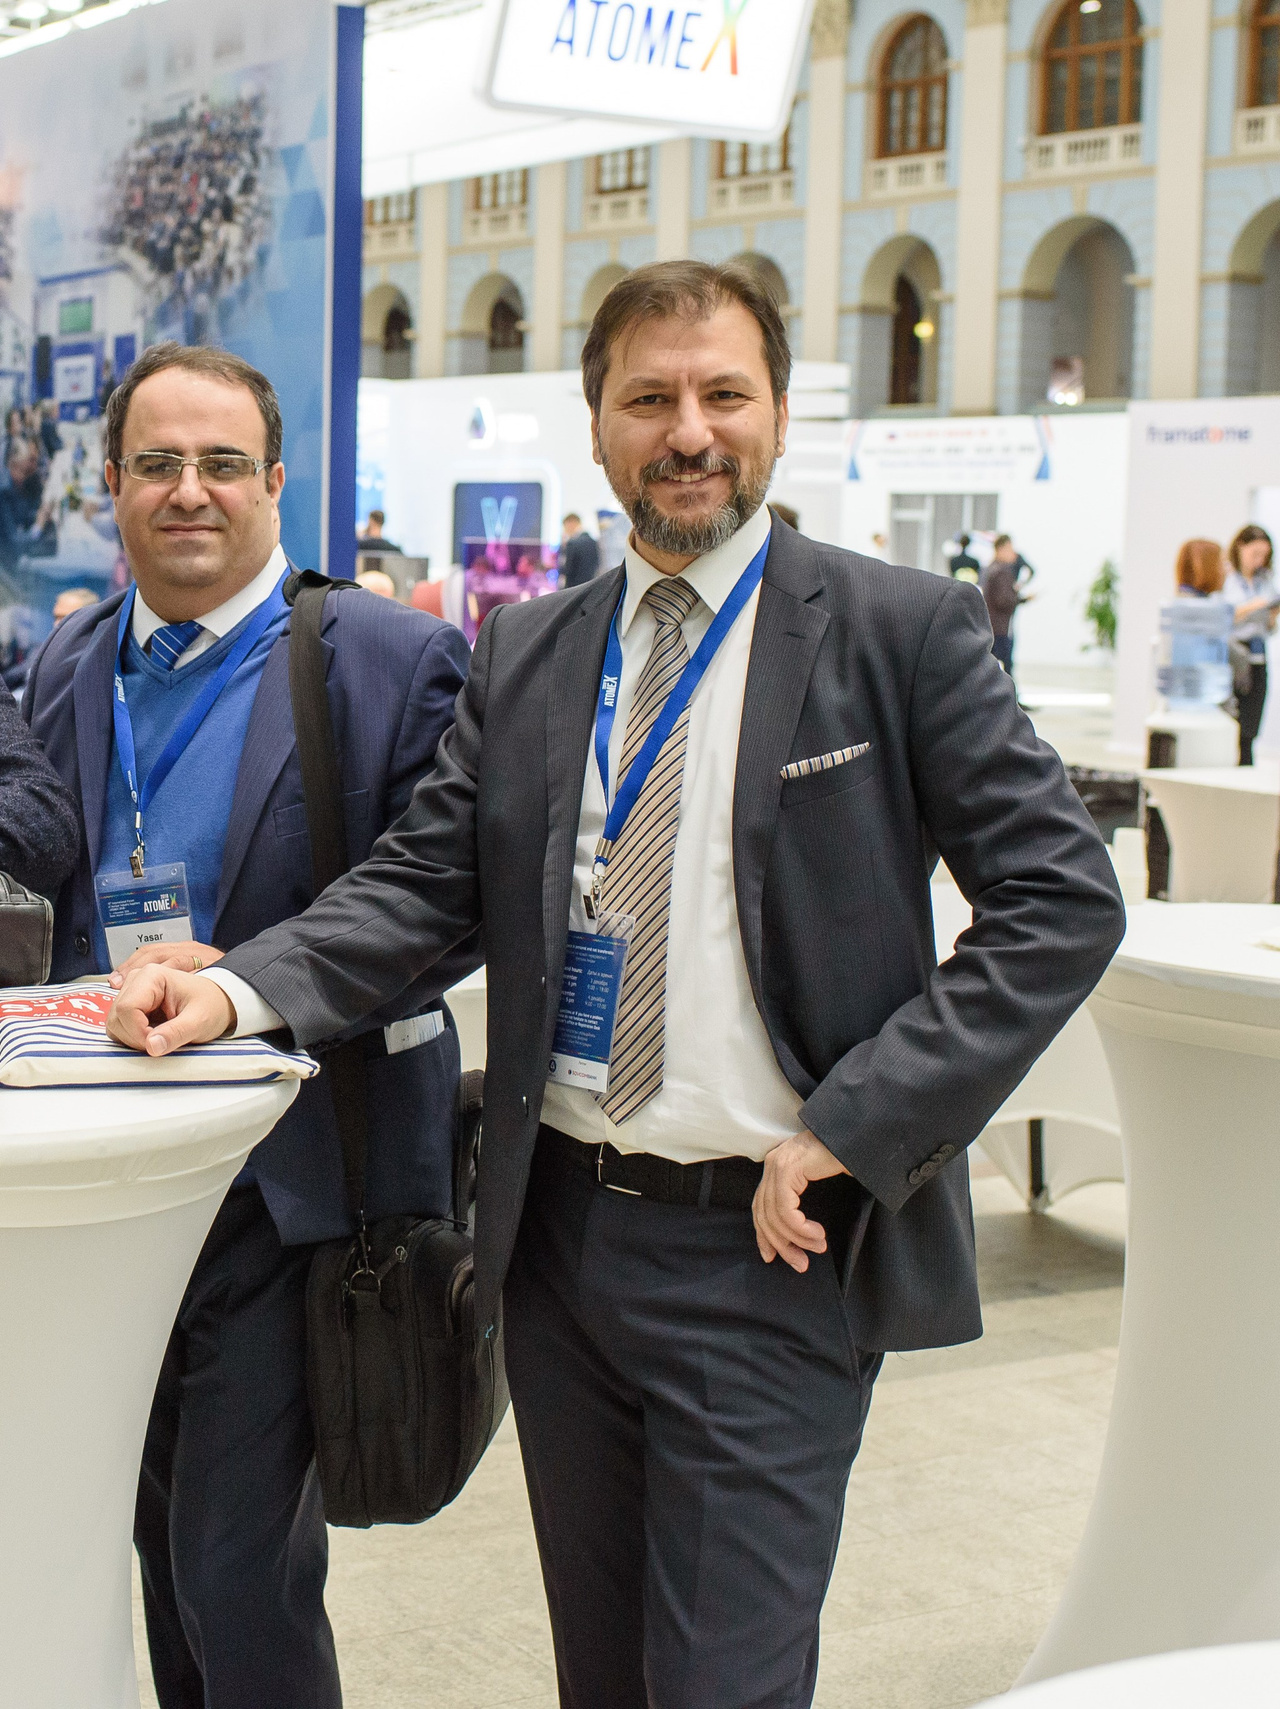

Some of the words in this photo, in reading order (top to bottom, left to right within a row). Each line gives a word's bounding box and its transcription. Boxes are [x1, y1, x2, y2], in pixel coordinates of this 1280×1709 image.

[550, 0, 748, 76] ATOMEX
[603, 674, 618, 707] ATOMEX
[144, 893, 179, 913] ATOMEX
[137, 933, 164, 942] Yasar
[1, 998, 105, 1014] STR
[64, 1012, 94, 1023] YORK
